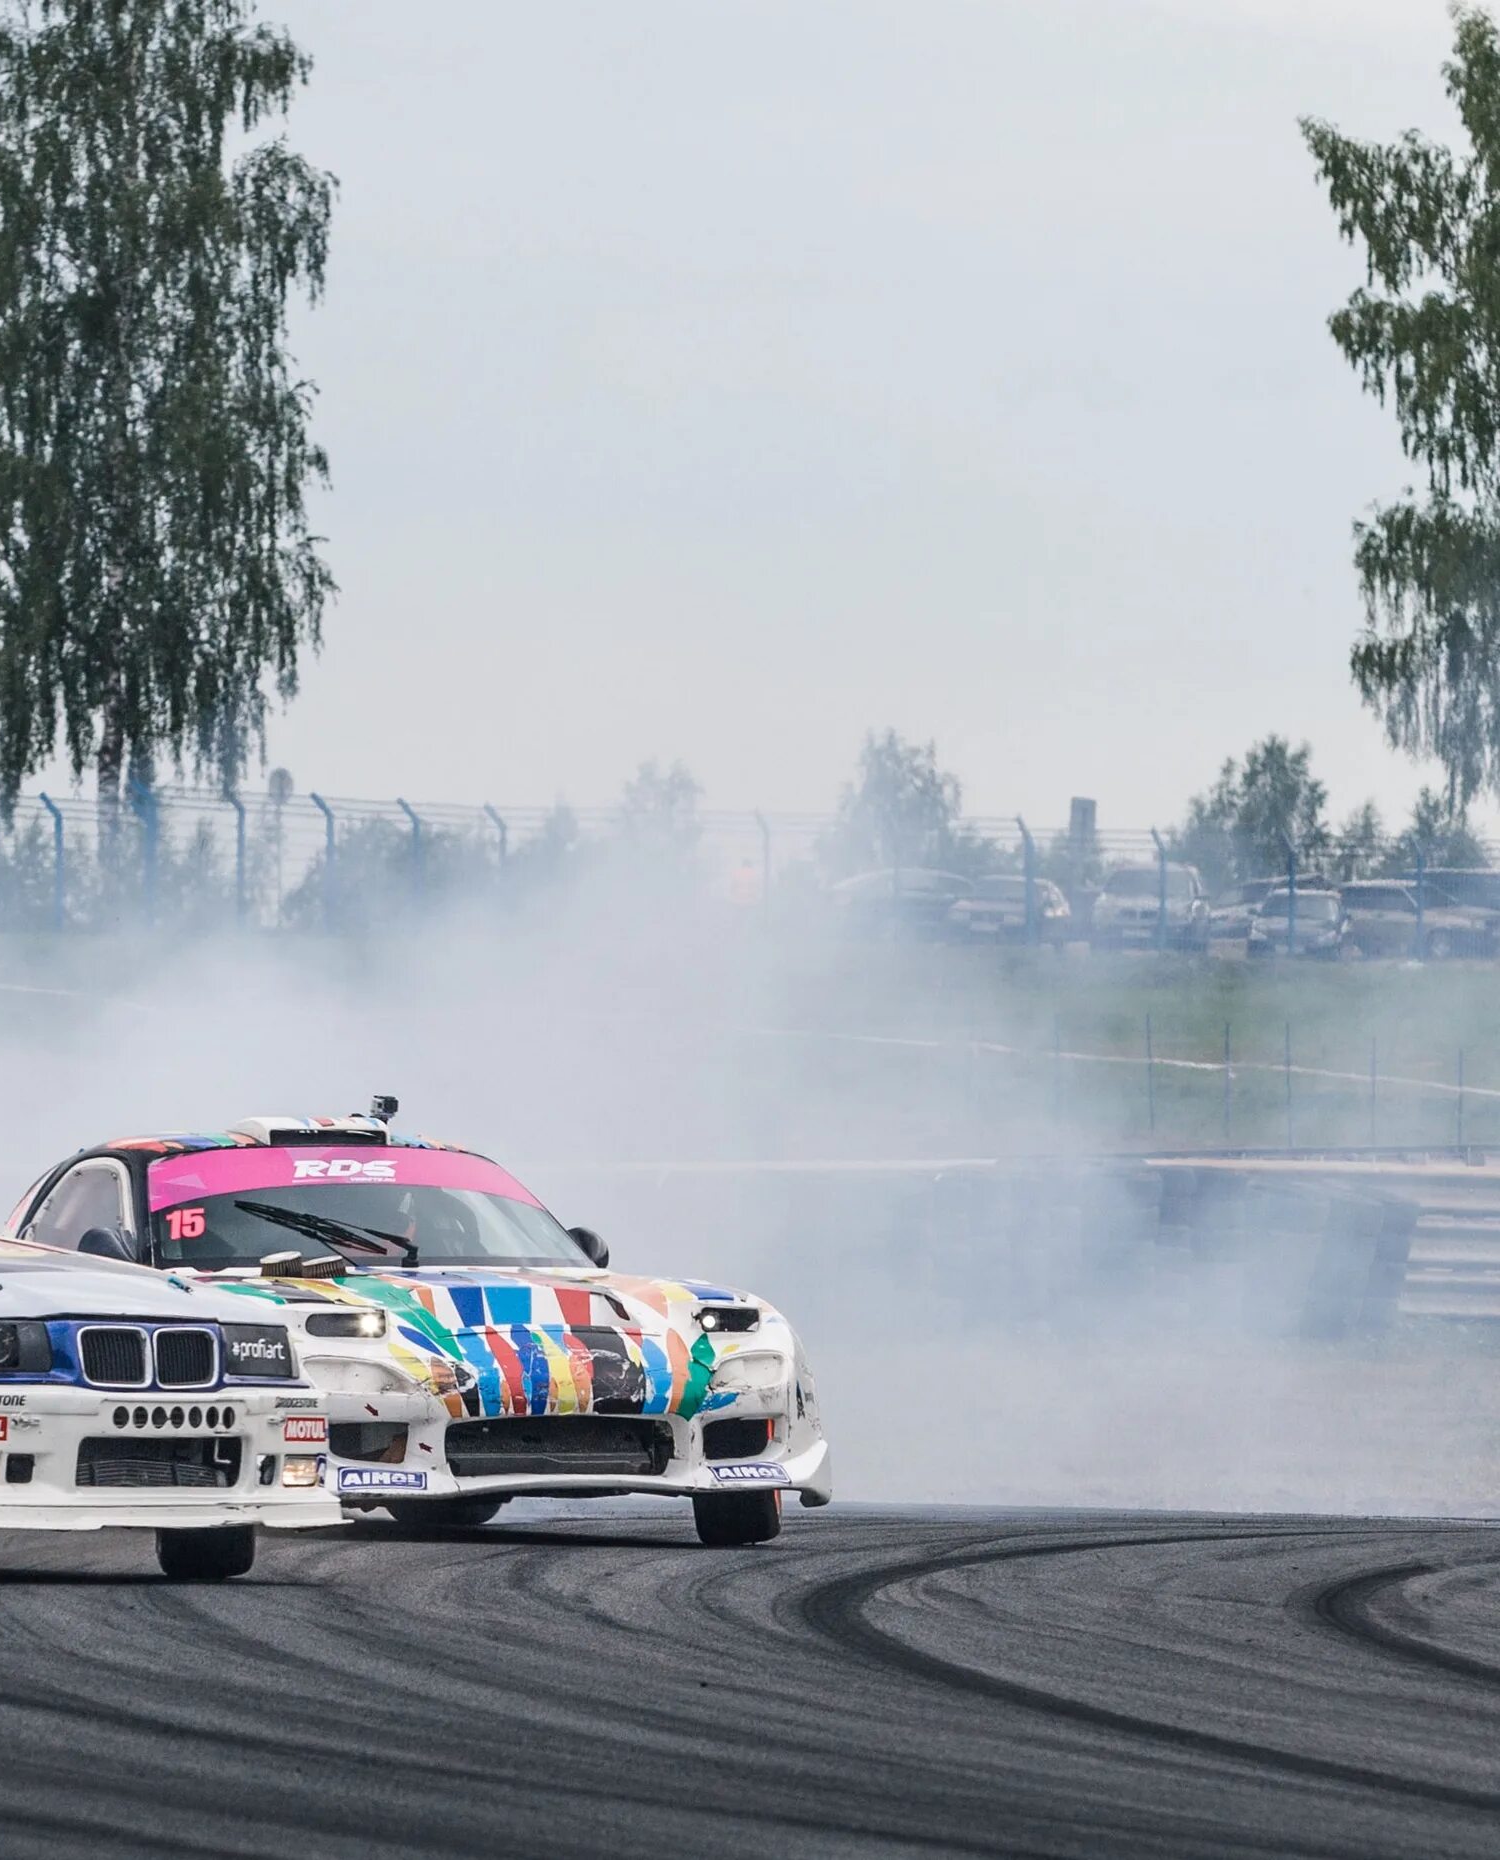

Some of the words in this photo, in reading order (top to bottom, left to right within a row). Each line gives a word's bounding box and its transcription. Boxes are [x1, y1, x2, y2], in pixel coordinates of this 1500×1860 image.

[292, 1159, 398, 1178] RDS
[165, 1207, 206, 1241] 15
[286, 1420, 325, 1439] MOTUL
[342, 1471, 421, 1486] AIMOL
[719, 1465, 785, 1479] AIMOL
